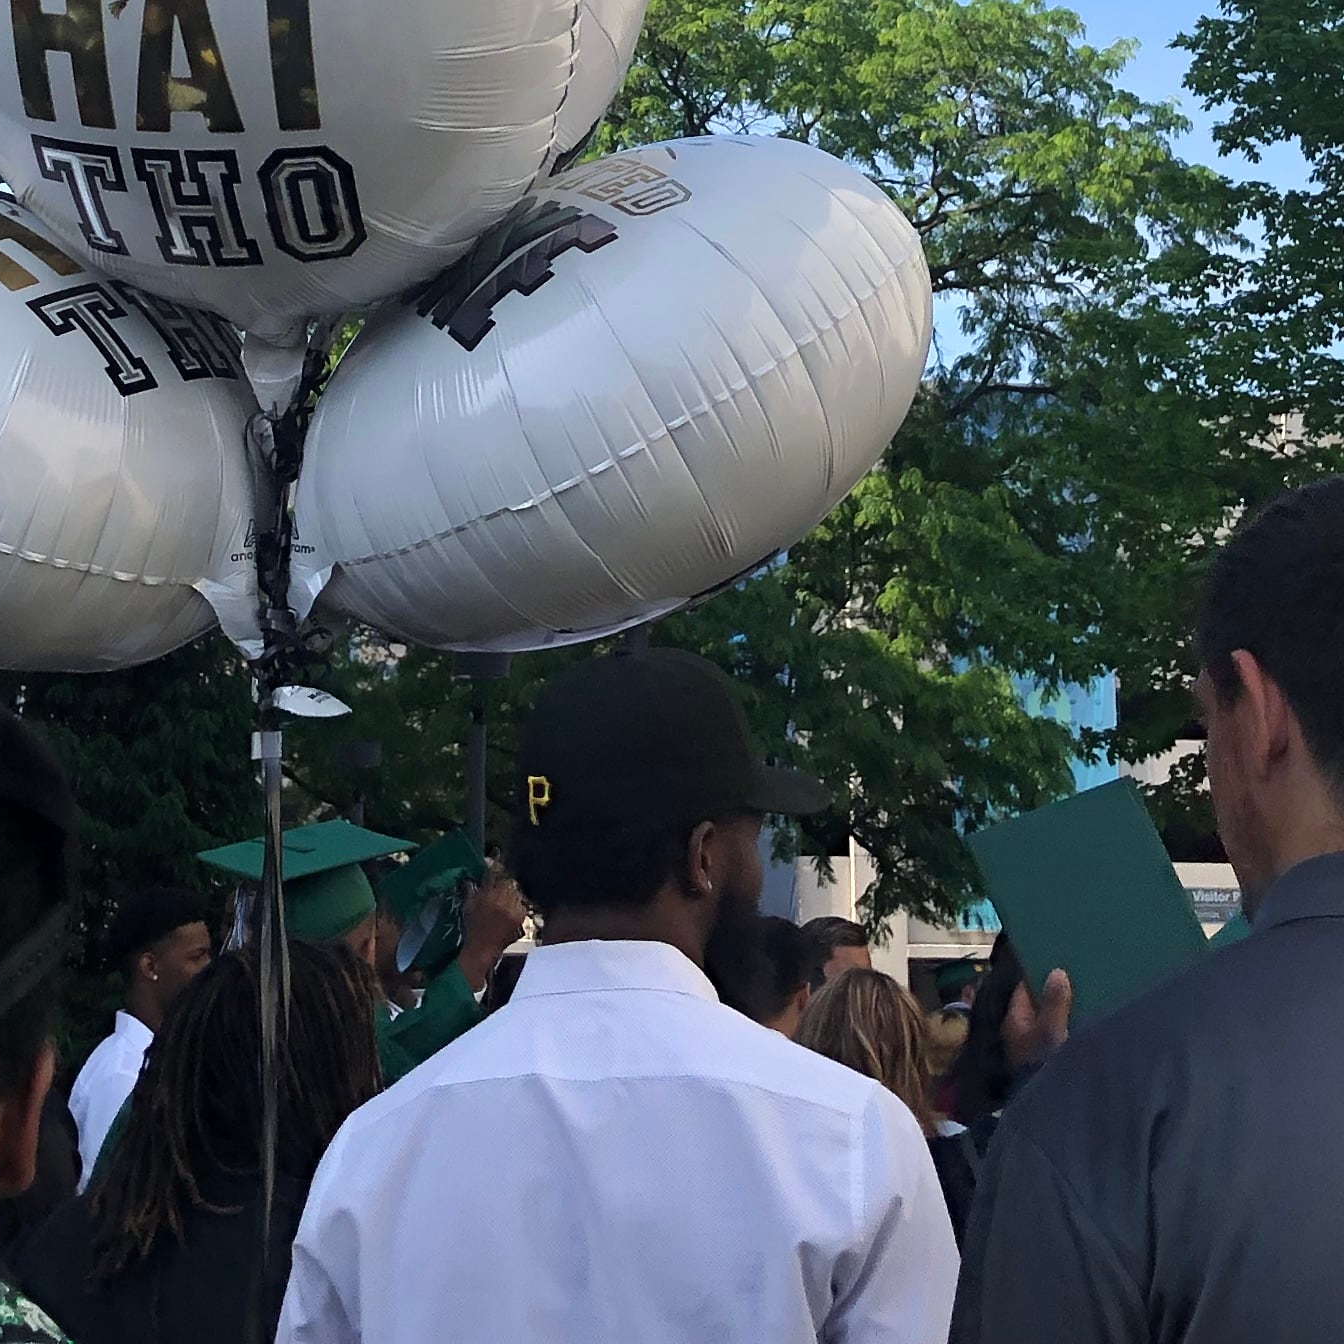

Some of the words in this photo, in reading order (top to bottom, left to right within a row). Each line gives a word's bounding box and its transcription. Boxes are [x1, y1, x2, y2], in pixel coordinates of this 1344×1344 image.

[31, 133, 367, 267] THO
[528, 775, 550, 825] P
[1193, 890, 1231, 902] Visitor
